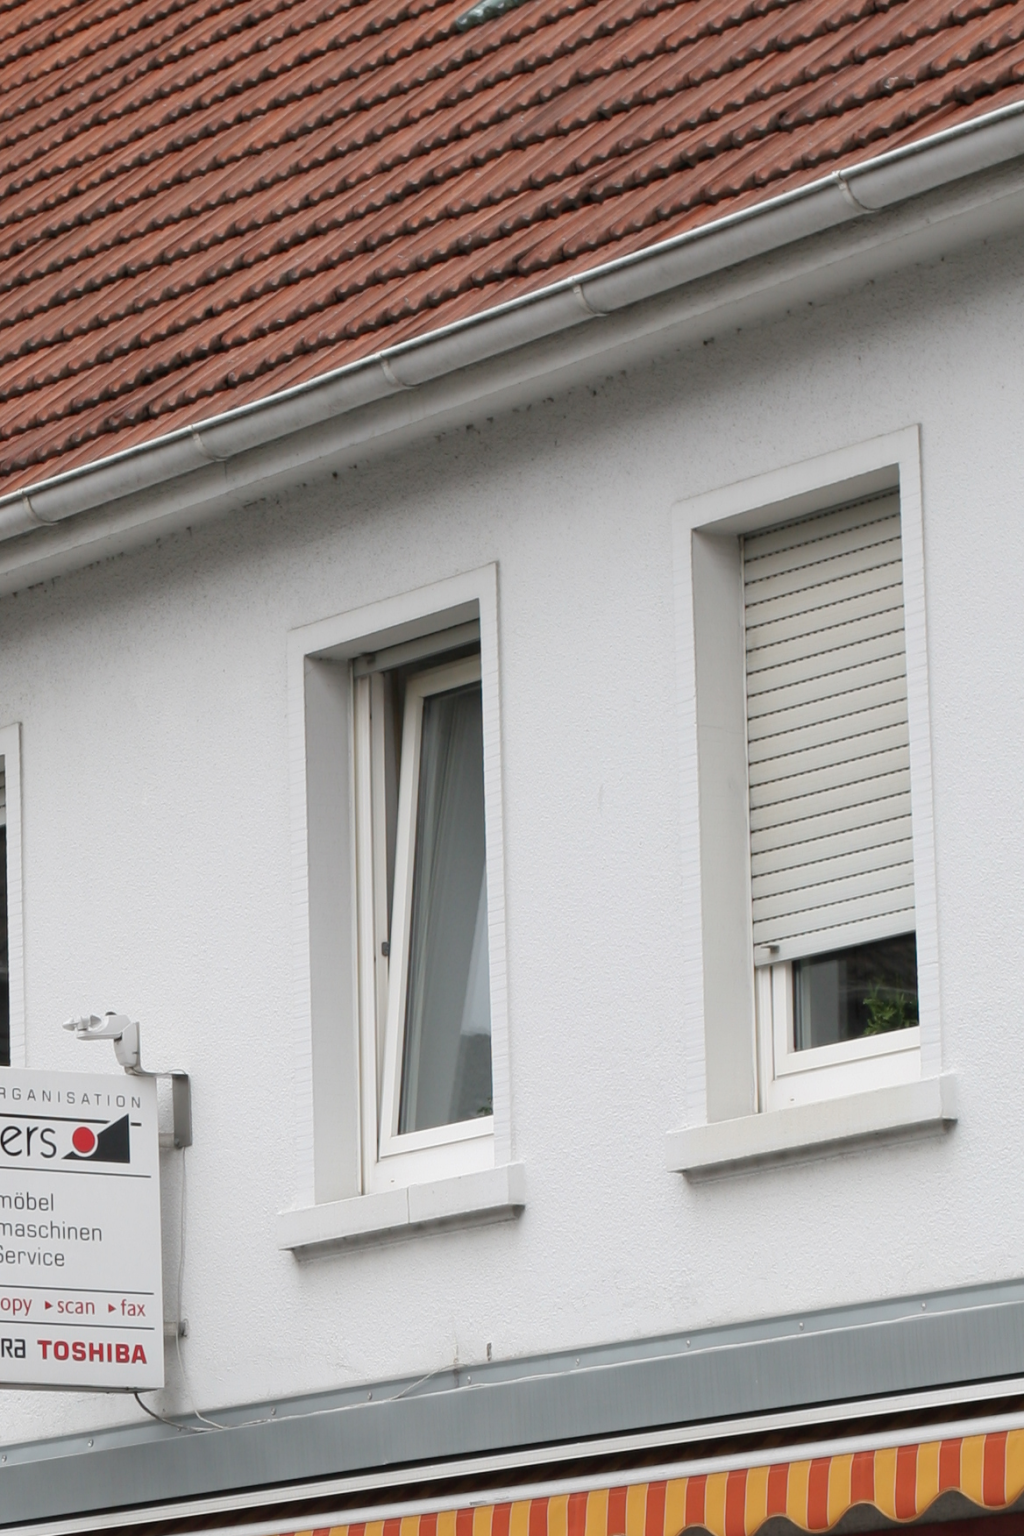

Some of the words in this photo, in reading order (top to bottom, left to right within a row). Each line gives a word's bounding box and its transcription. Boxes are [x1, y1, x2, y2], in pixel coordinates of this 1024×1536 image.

[57, 1300, 95, 1315] scan
[120, 1299, 147, 1317] fax
[37, 1339, 148, 1364] TOSHIBA
